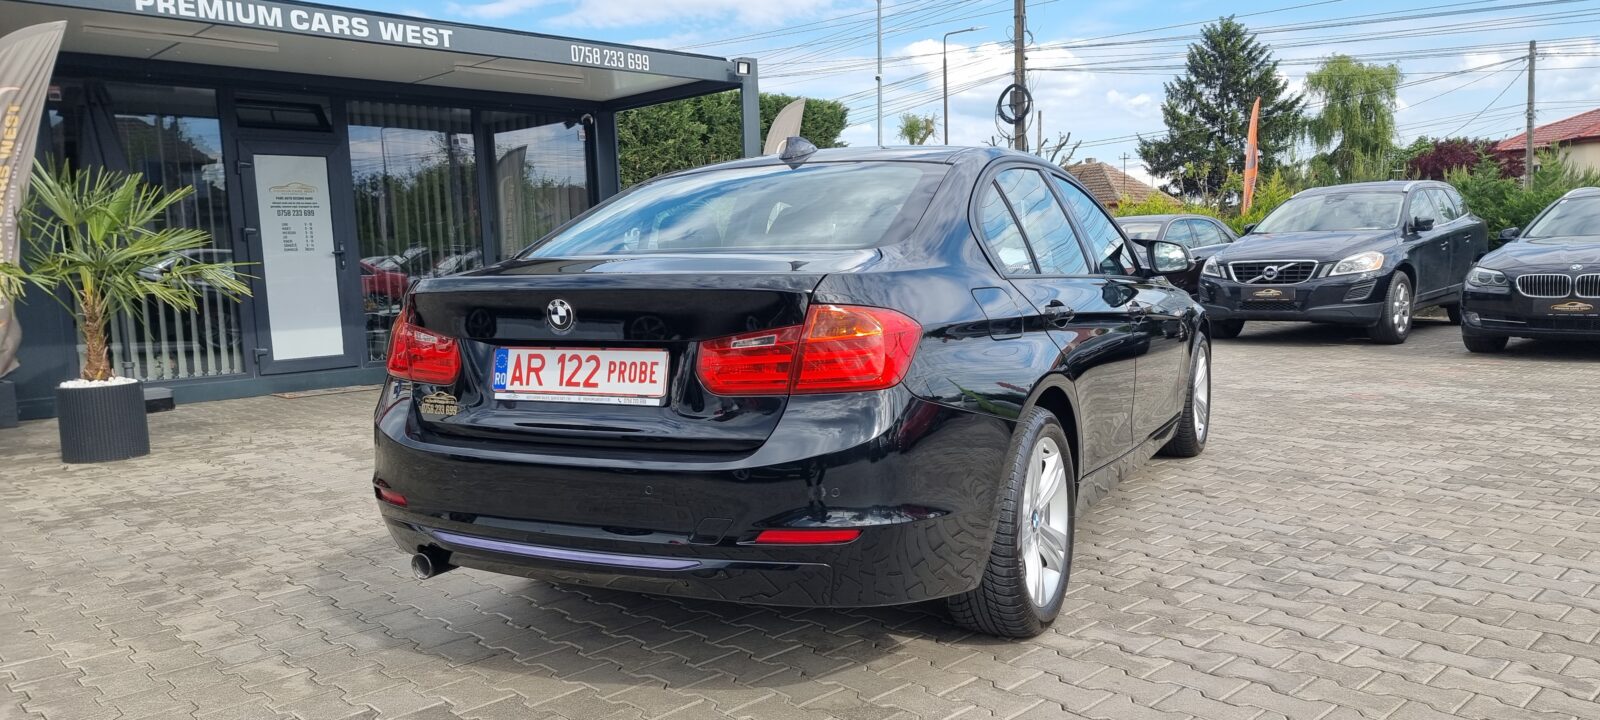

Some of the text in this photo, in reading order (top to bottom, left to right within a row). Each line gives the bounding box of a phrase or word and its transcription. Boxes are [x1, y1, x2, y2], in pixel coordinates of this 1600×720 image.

[135, 0, 453, 48] PREMIUM CARS WEST
[571, 45, 650, 71] 0758 233 699
[494, 372, 507, 386] RO
[509, 353, 660, 389] AR 122 PROBE
